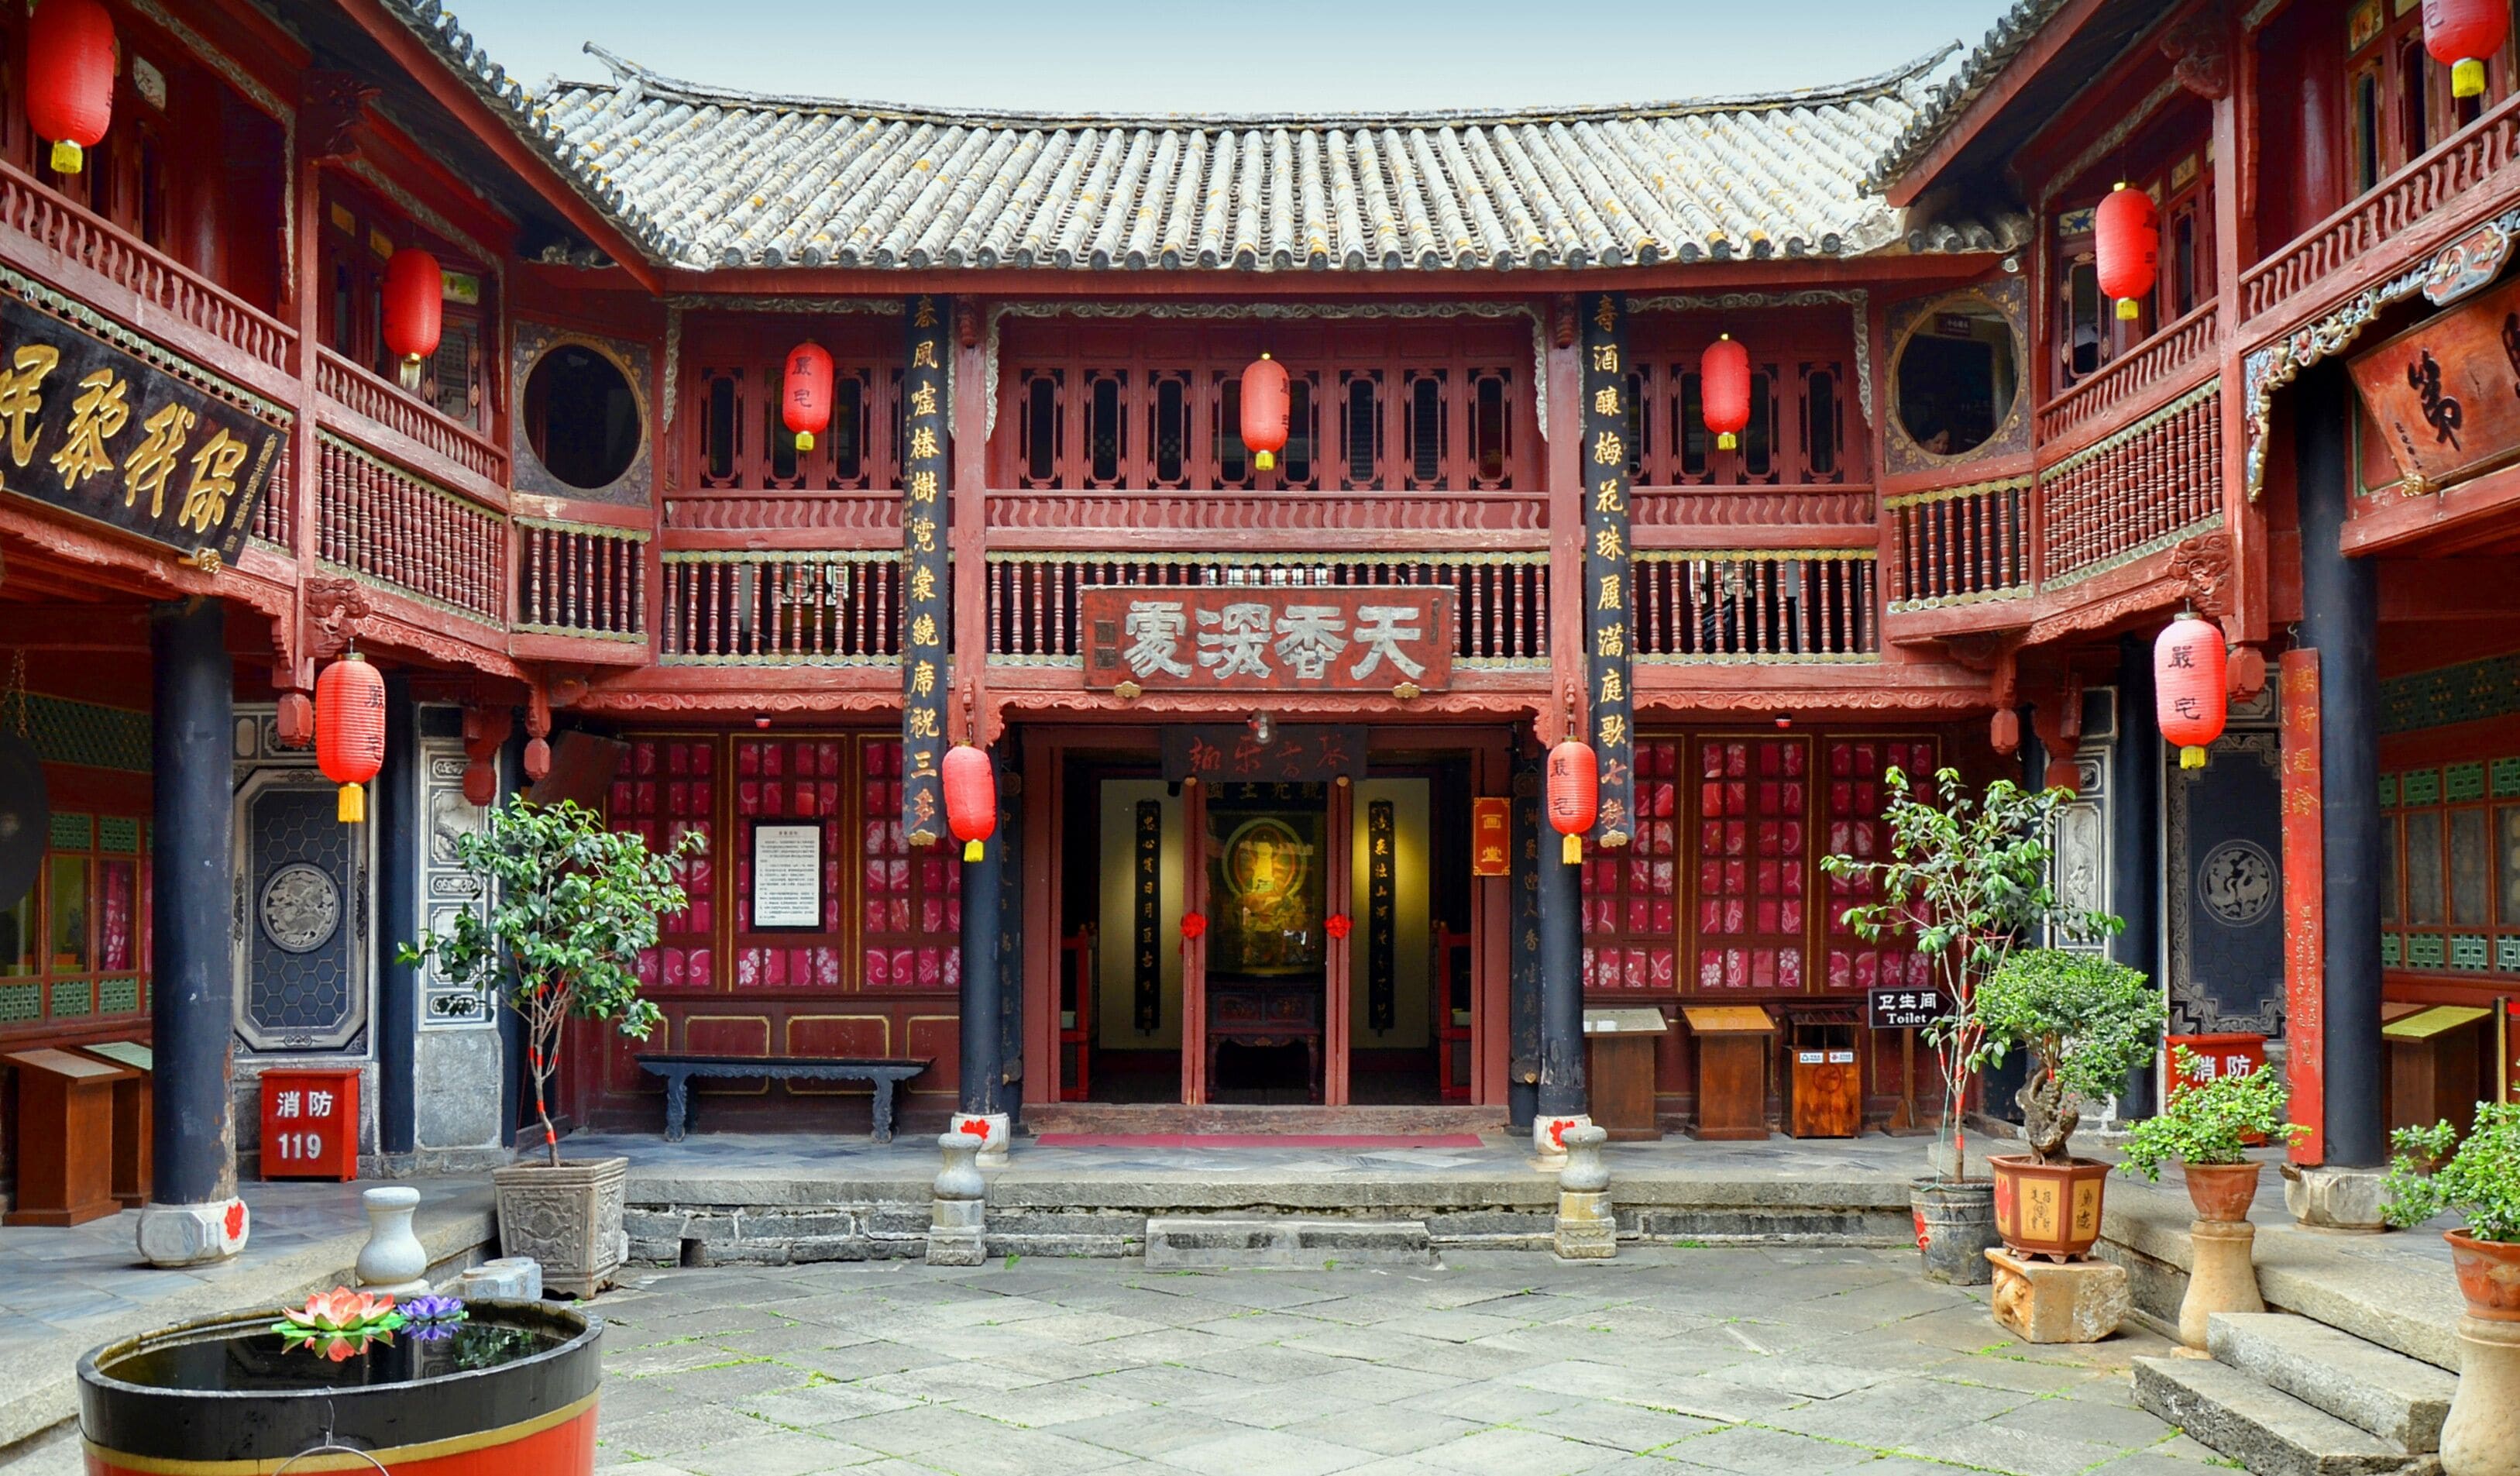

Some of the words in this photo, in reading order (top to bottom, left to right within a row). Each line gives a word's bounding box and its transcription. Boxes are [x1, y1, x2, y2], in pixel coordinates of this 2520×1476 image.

[2168, 645, 2201, 720] 嚴宅
[1878, 993, 1937, 1010] 卫生间
[1886, 1012, 1927, 1024] Toilet
[2192, 1055, 2252, 1082] 消防
[277, 1090, 333, 1117] 消防
[278, 1133, 321, 1159] 119
